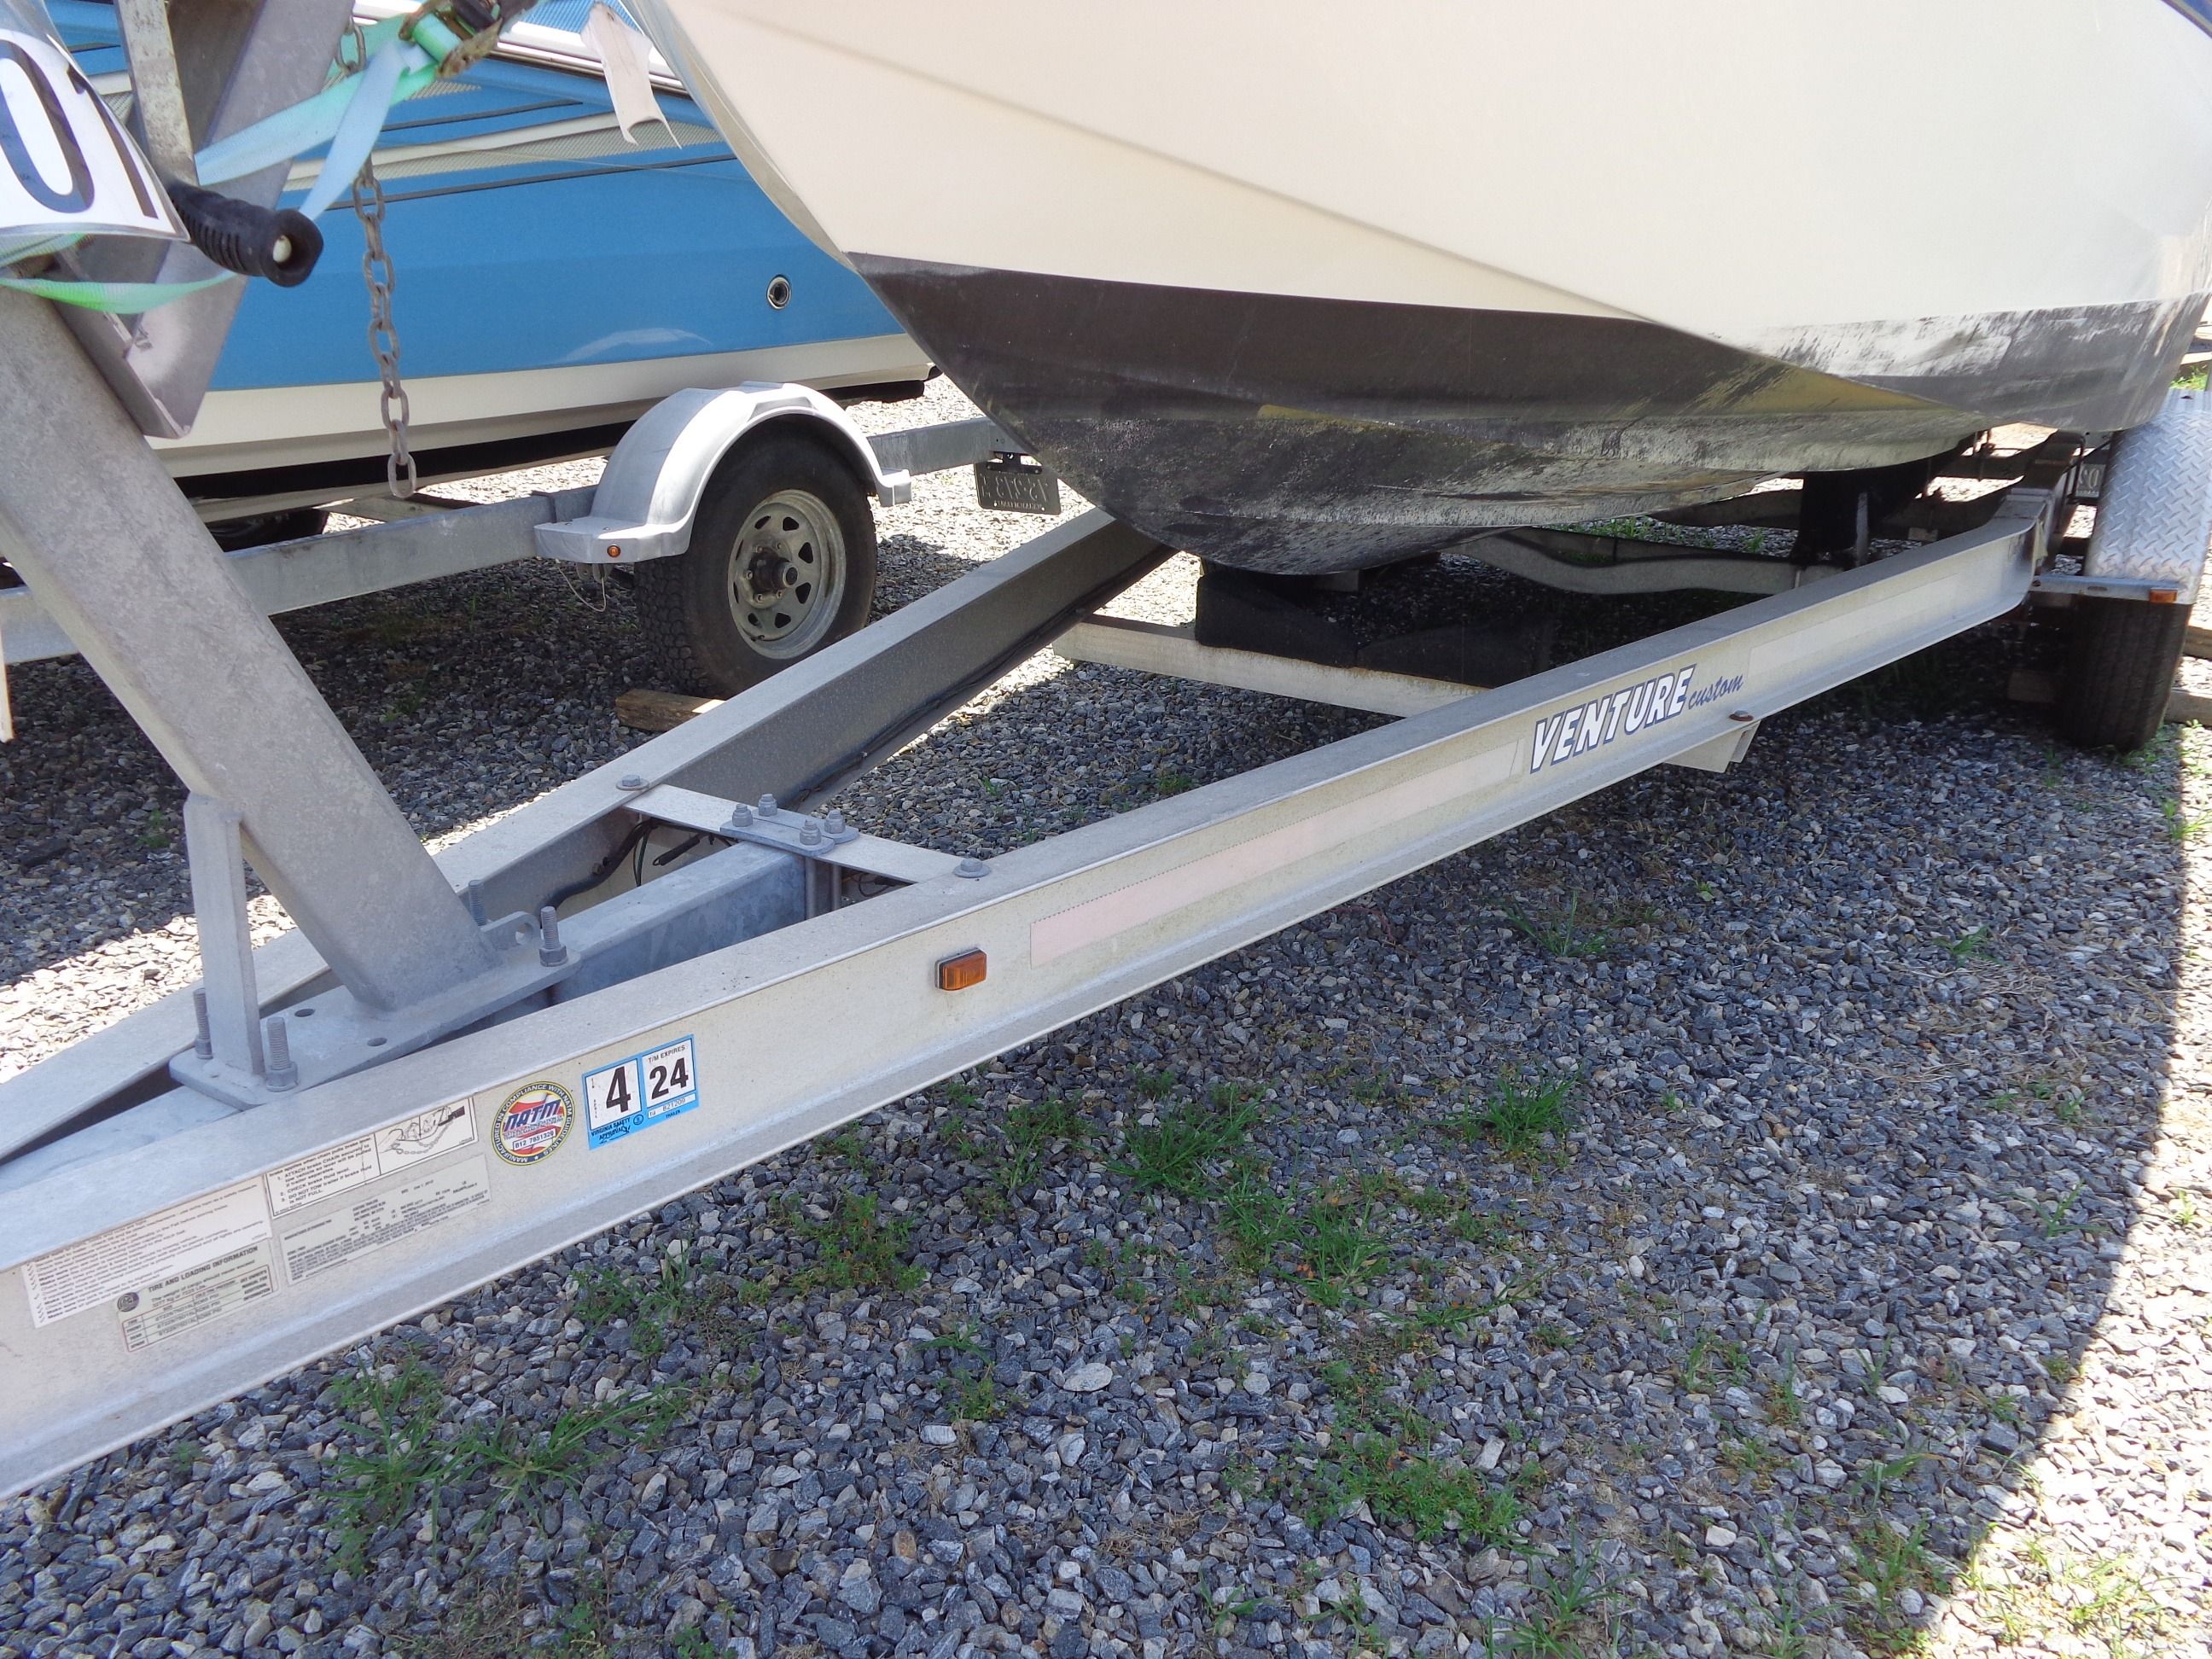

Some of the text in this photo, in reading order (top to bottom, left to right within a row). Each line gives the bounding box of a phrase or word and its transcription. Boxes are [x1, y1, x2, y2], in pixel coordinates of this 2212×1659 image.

[1530, 663, 1743, 773] VENTURE custom
[660, 1043, 685, 1059] EXPIRES
[548, 1085, 564, 1097] WITH
[606, 1066, 631, 1113] 4
[649, 1057, 689, 1100] 24
[502, 1084, 547, 1112] COMPLIANCE
[498, 1112, 504, 1121] IN
[590, 1116, 631, 1137] VIRGINIA SAFETY
[494, 1122, 528, 1163] MANUFACTURED
[284, 1166, 306, 1178] ATTACH
[322, 1153, 340, 1164] CHAIN
[286, 1182, 306, 1193] CHECK
[309, 1183, 322, 1191] TOW
[148, 1242, 259, 1294] TIRE AND LOADING INFORMATION
